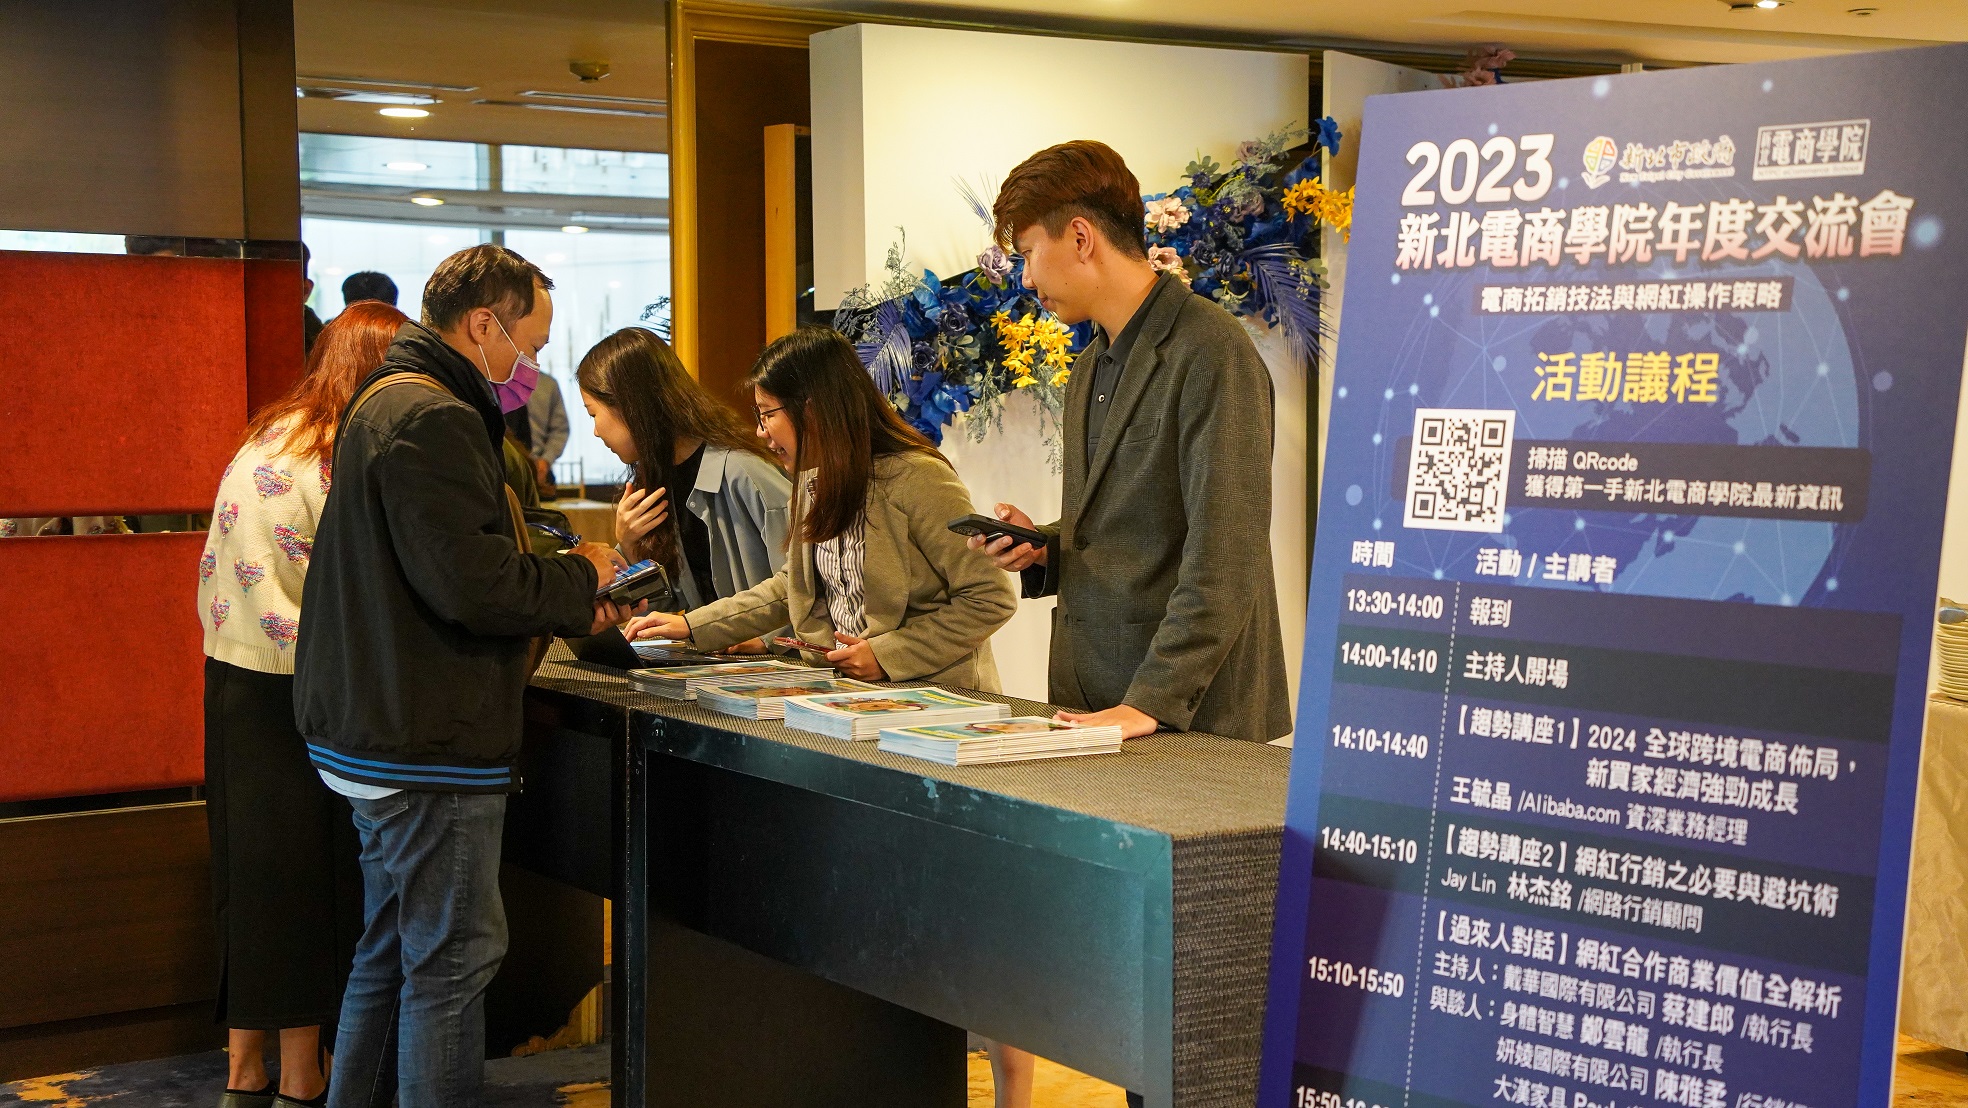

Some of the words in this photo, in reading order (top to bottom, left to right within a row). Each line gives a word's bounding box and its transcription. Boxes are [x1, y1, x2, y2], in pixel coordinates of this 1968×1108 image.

[1401, 134, 1554, 206] 2023
[1619, 135, 1736, 172] 新北市政府
[1395, 189, 1914, 270] 新北電商學院年度交流會
[1481, 281, 1782, 312] 電商拓銷技法與網紅操作策略
[1531, 351, 1720, 403] 活動議程
[1528, 446, 1567, 471] 掃描
[1573, 451, 1638, 472] QRcode
[1525, 474, 1843, 511] 獲得第一手新北電商學院最新資訊
[1351, 540, 1395, 568] 時間
[1475, 547, 1521, 578] 活動
[1543, 552, 1617, 584] 主講者
[1347, 589, 1443, 619] 13:30-14:00
[1470, 596, 1512, 628] 報到
[1342, 642, 1438, 673] 14:00-14:10
[1463, 650, 1568, 689] 主持人開場
[1333, 724, 1428, 759] 14:10-14:40
[1586, 758, 1800, 815] 新買家經濟強勁成長
[1626, 803, 1748, 846] 資深業務經理
[1322, 826, 1417, 864] 14:40-15:10
[1441, 867, 1467, 892] Jay
[1471, 871, 1497, 894] Lin
[1507, 870, 1573, 911] 林杰銘
[1309, 956, 1404, 998] 15:10-15:50
[1662, 992, 1735, 1036] 蔡建郎
